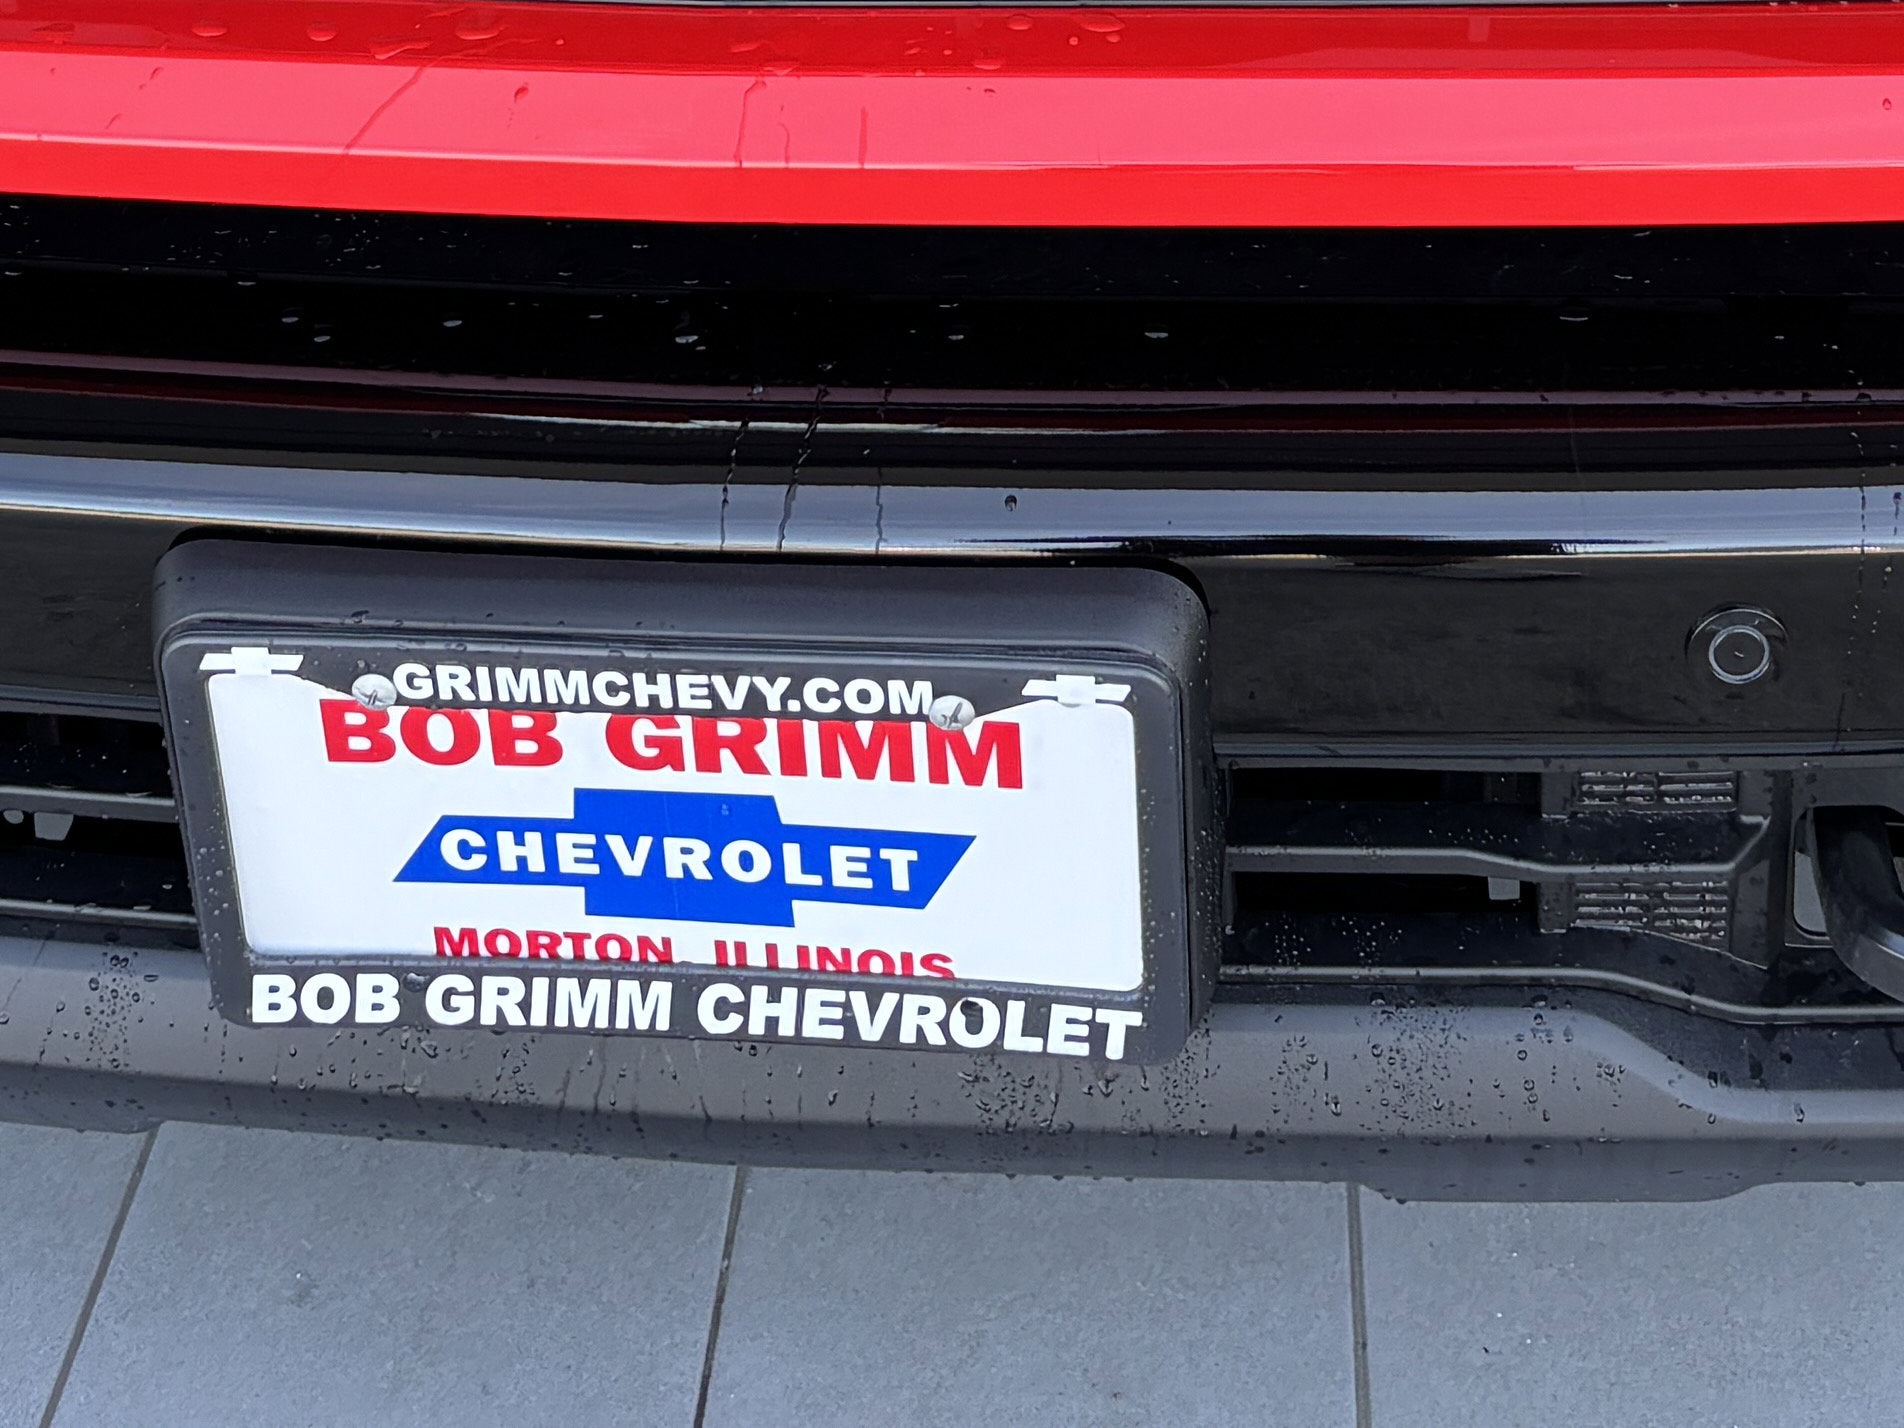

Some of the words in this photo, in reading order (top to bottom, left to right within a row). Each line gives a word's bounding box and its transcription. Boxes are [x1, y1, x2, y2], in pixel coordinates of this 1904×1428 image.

[392, 662, 933, 715] GRIMMCHEVY.COM
[320, 699, 564, 768] BOB
[605, 713, 1024, 790] GRIMM
[440, 829, 919, 891] CHEVROLET
[251, 973, 401, 1024] BOB
[425, 974, 673, 1031] GRIMM
[697, 982, 1143, 1060] CHEVROLET
